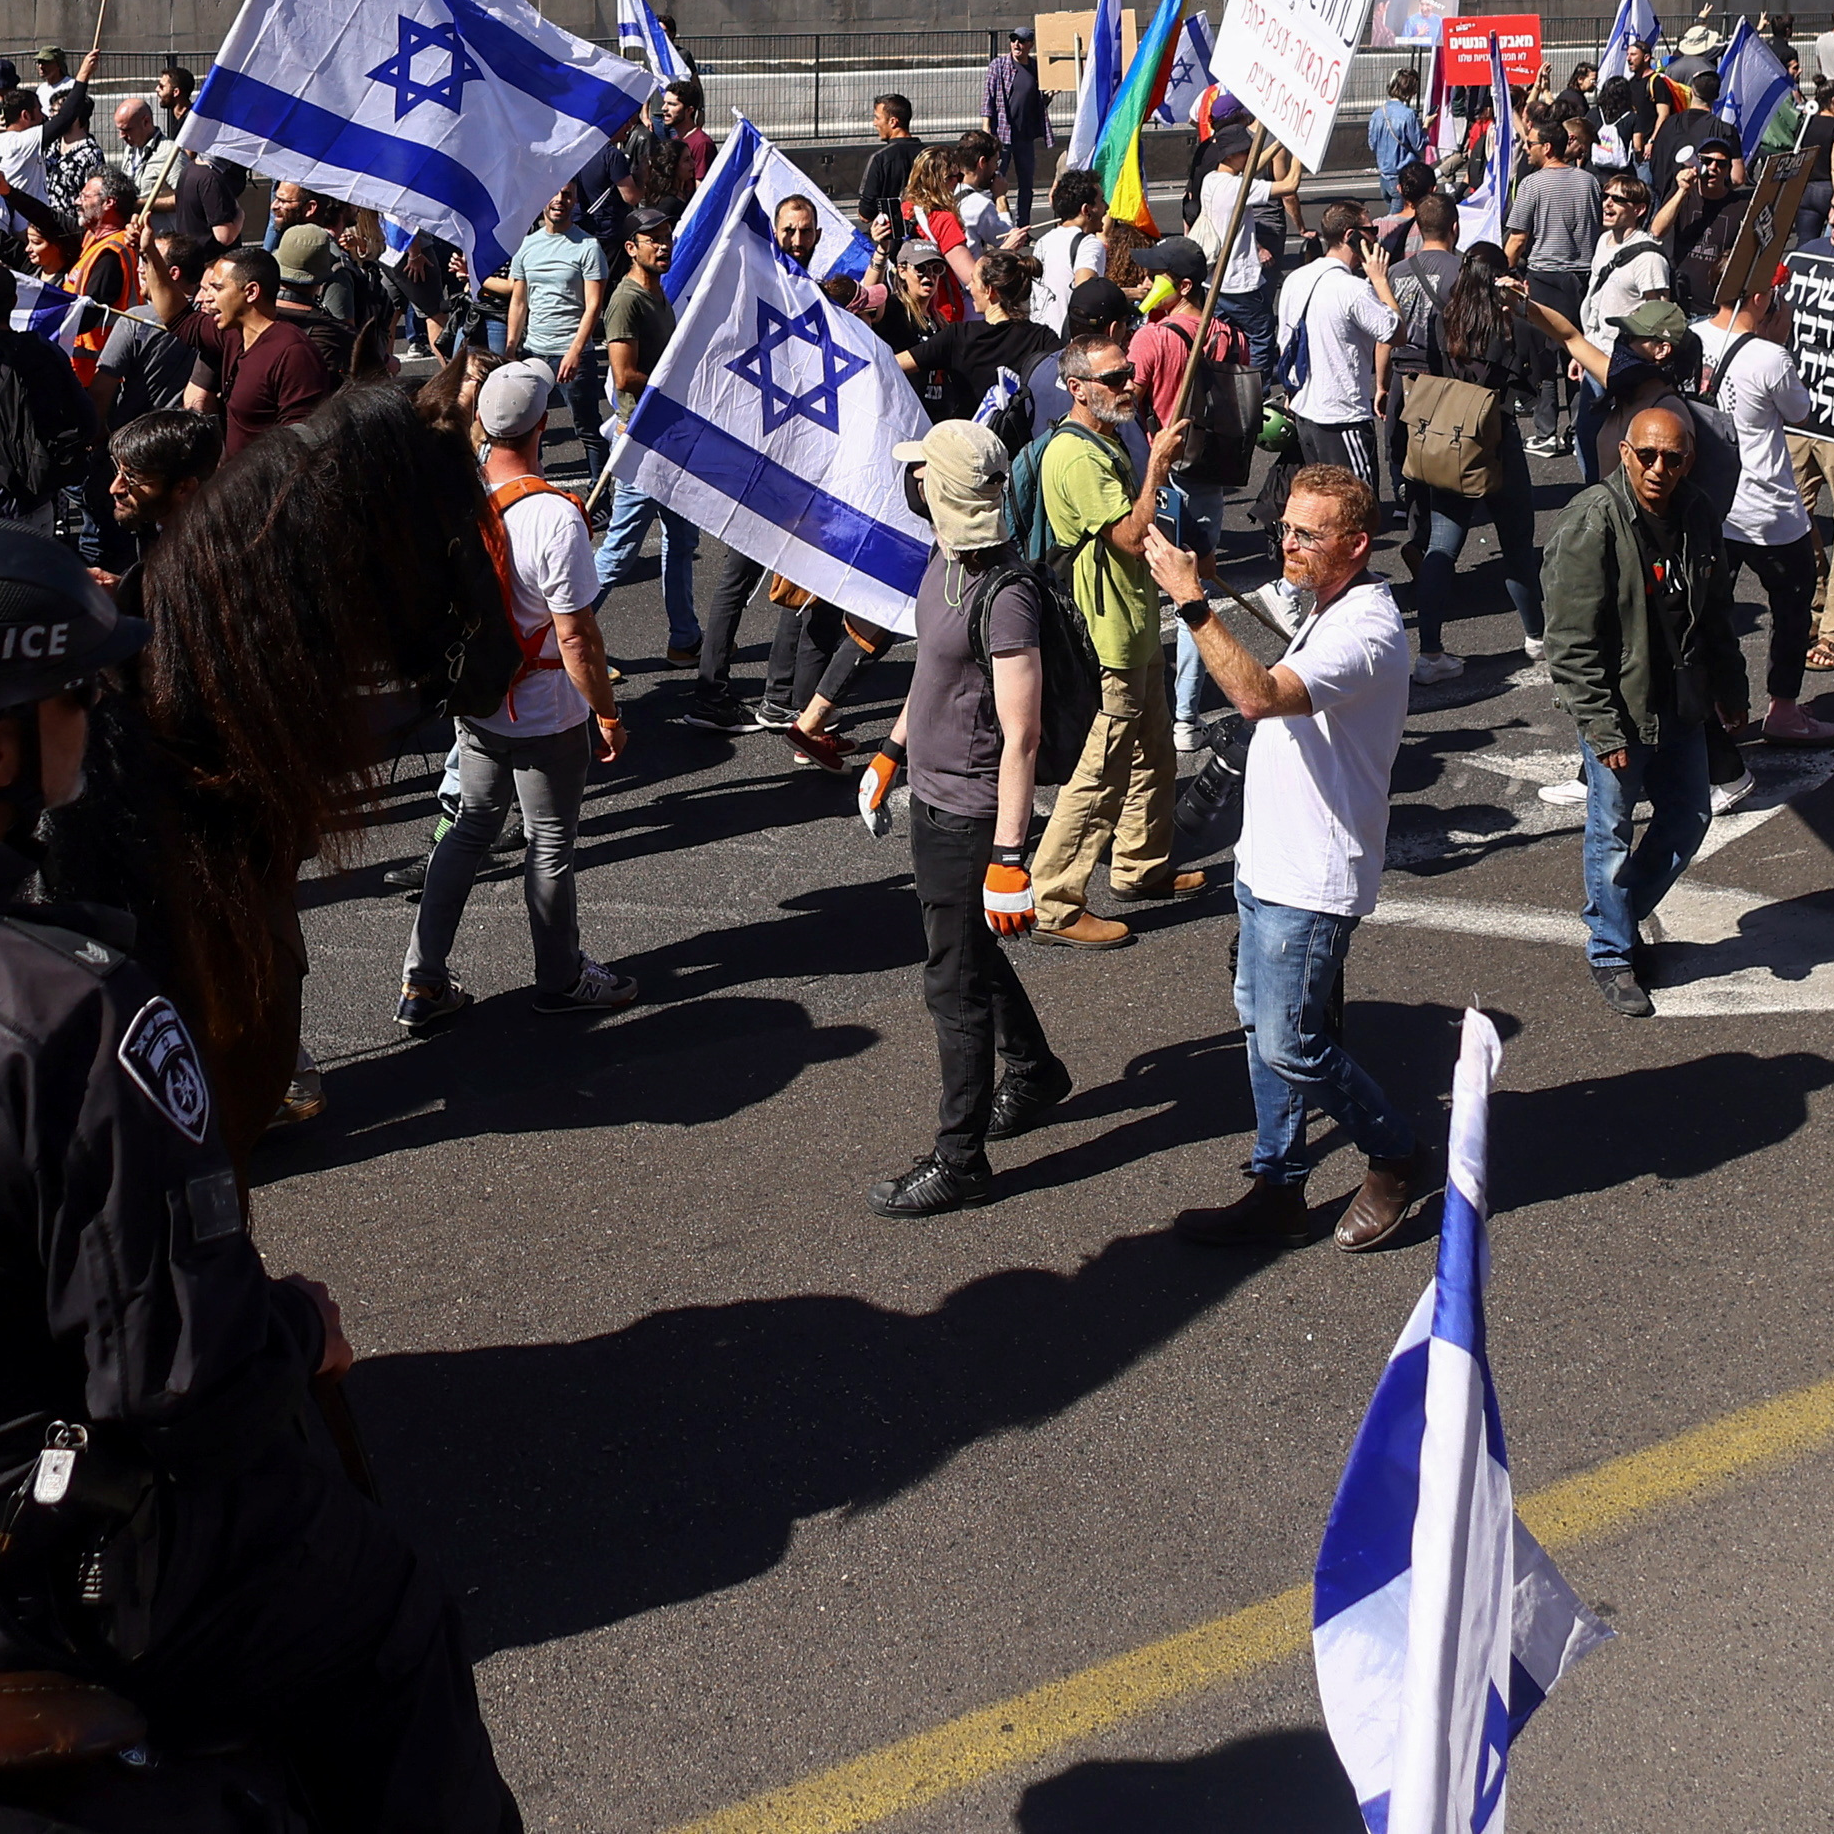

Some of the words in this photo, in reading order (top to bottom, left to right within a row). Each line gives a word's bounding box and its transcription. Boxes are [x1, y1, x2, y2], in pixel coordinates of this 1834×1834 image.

[1449, 36, 1487, 50] הנשים
[1498, 35, 1534, 49] מאבק
[1458, 53, 1472, 63] שלנו
[1518, 52, 1527, 61] לא
[1320, 60, 1341, 105] כל
